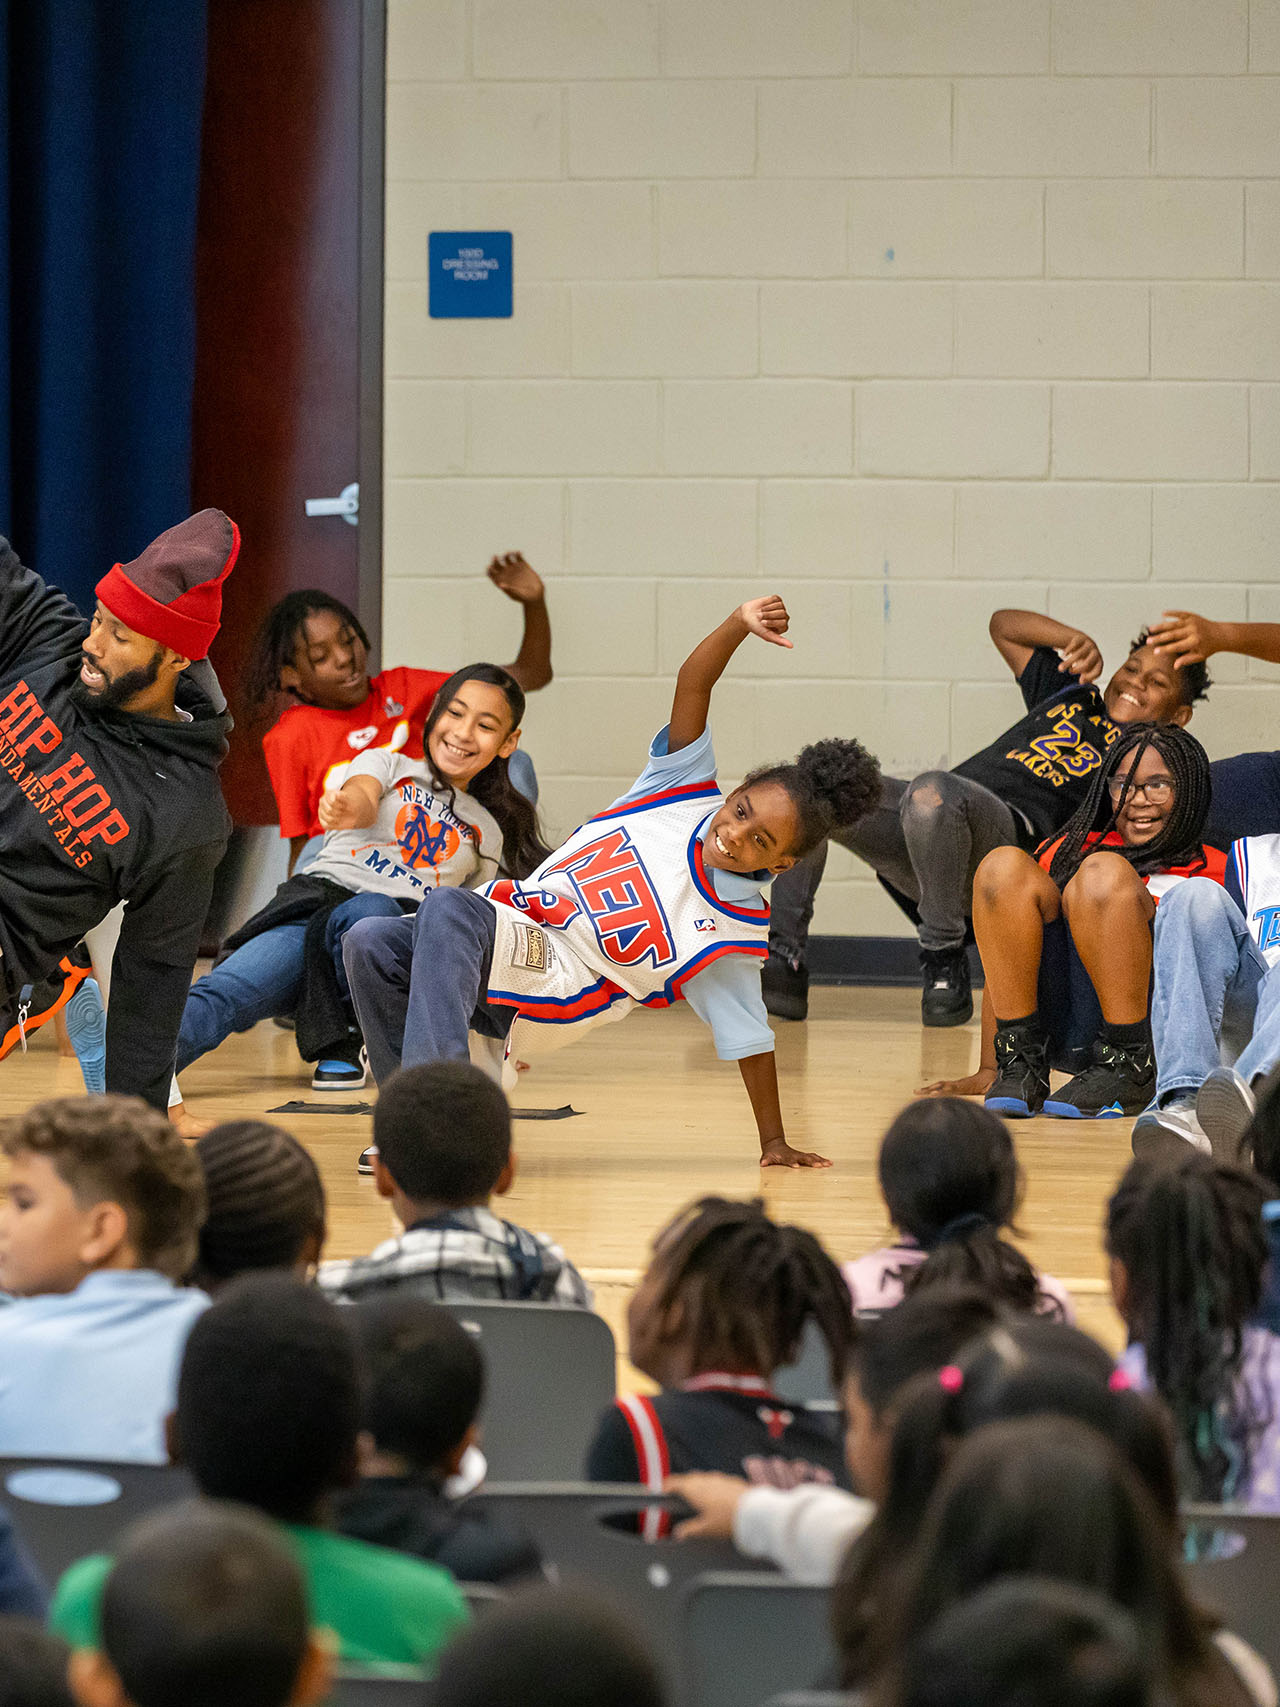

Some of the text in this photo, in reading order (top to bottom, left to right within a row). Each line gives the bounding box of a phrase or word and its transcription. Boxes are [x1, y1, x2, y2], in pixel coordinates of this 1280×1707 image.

[442, 258, 499, 270] DRESSING
[453, 270, 488, 281] ROOM
[1030, 719, 1102, 777] 23
[1005, 749, 1070, 787] LAKERS
[39, 752, 130, 846] HOP
[402, 785, 435, 811] NEW
[538, 826, 677, 969] NETS
